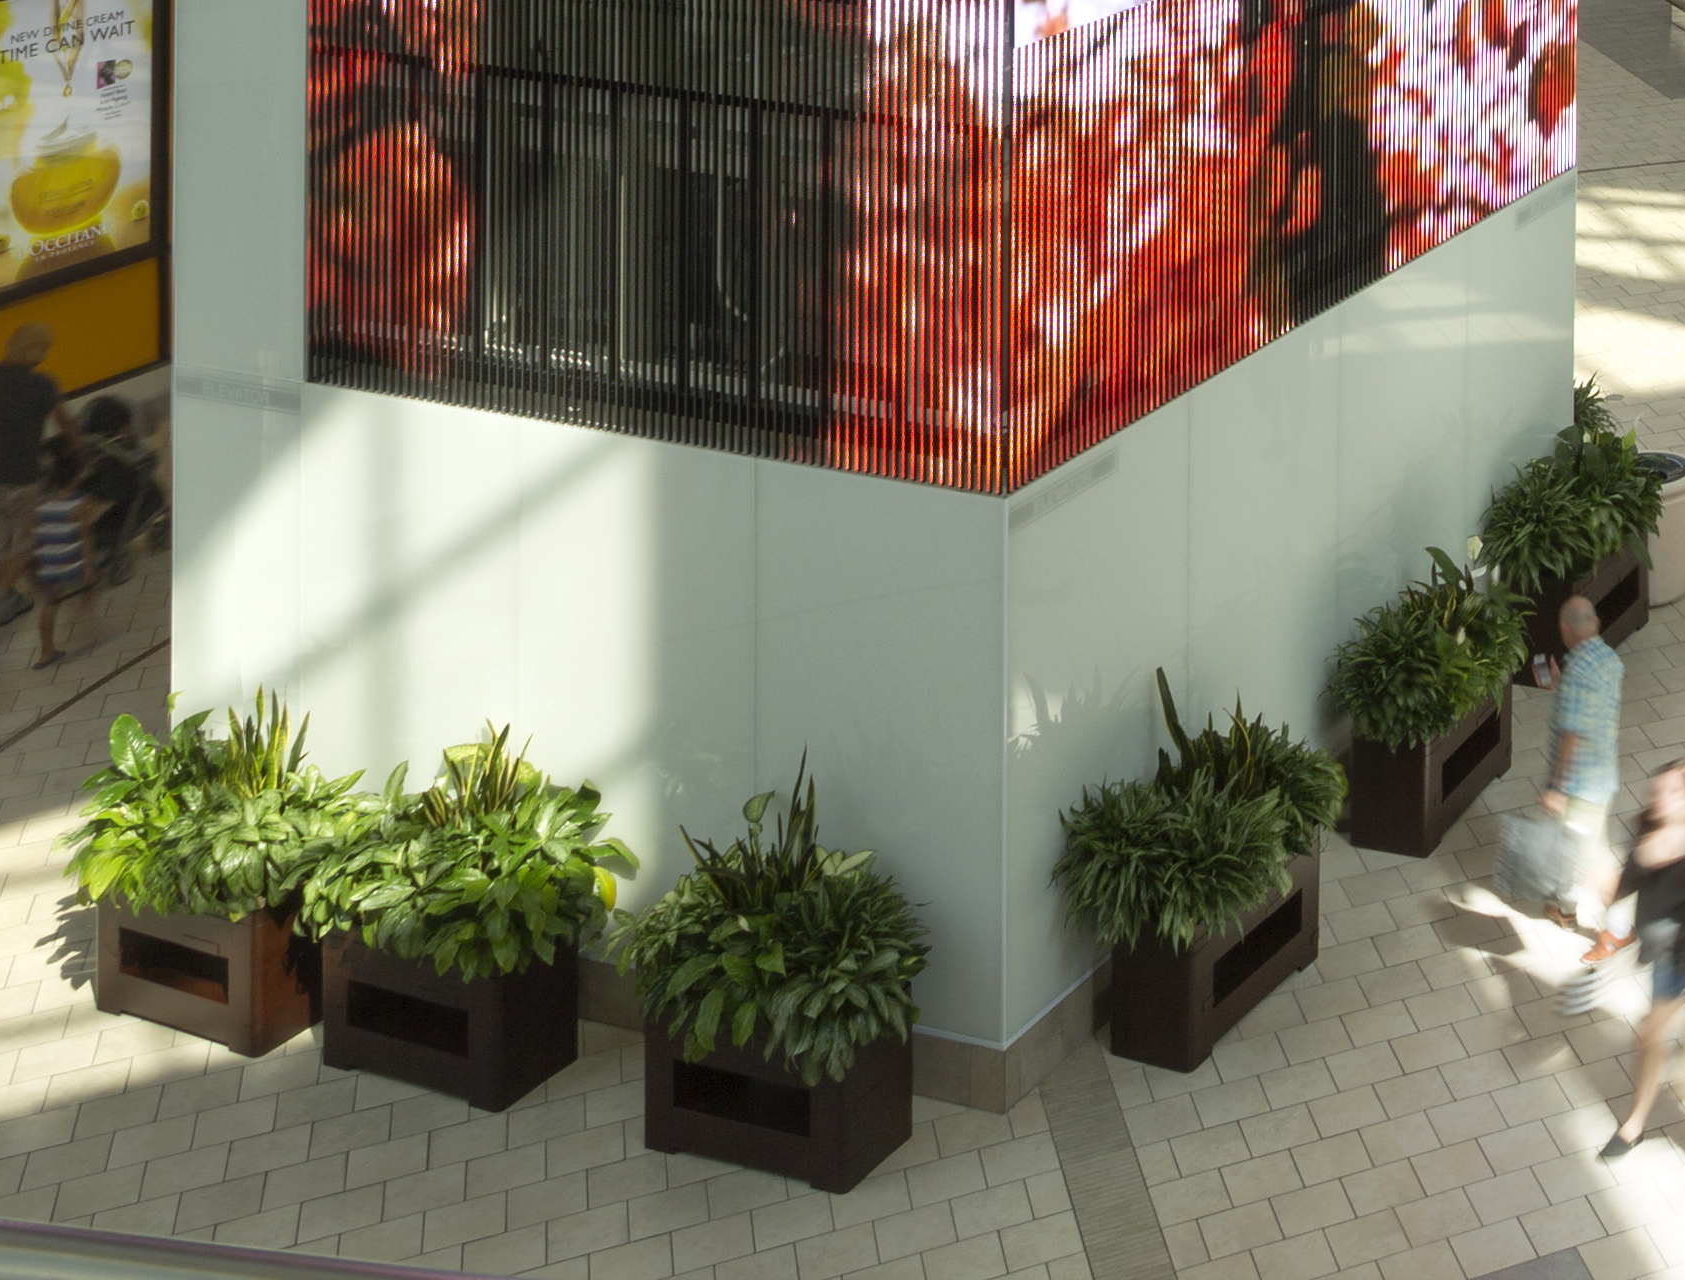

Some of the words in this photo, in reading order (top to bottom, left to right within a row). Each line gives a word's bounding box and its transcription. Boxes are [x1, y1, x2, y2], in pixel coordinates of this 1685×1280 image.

[10, 29, 40, 45] NEW
[43, 19, 83, 38] DIVINE
[85, 10, 125, 27] CREAM
[45, 33, 85, 54] CAN
[90, 20, 136, 42] WAIT
